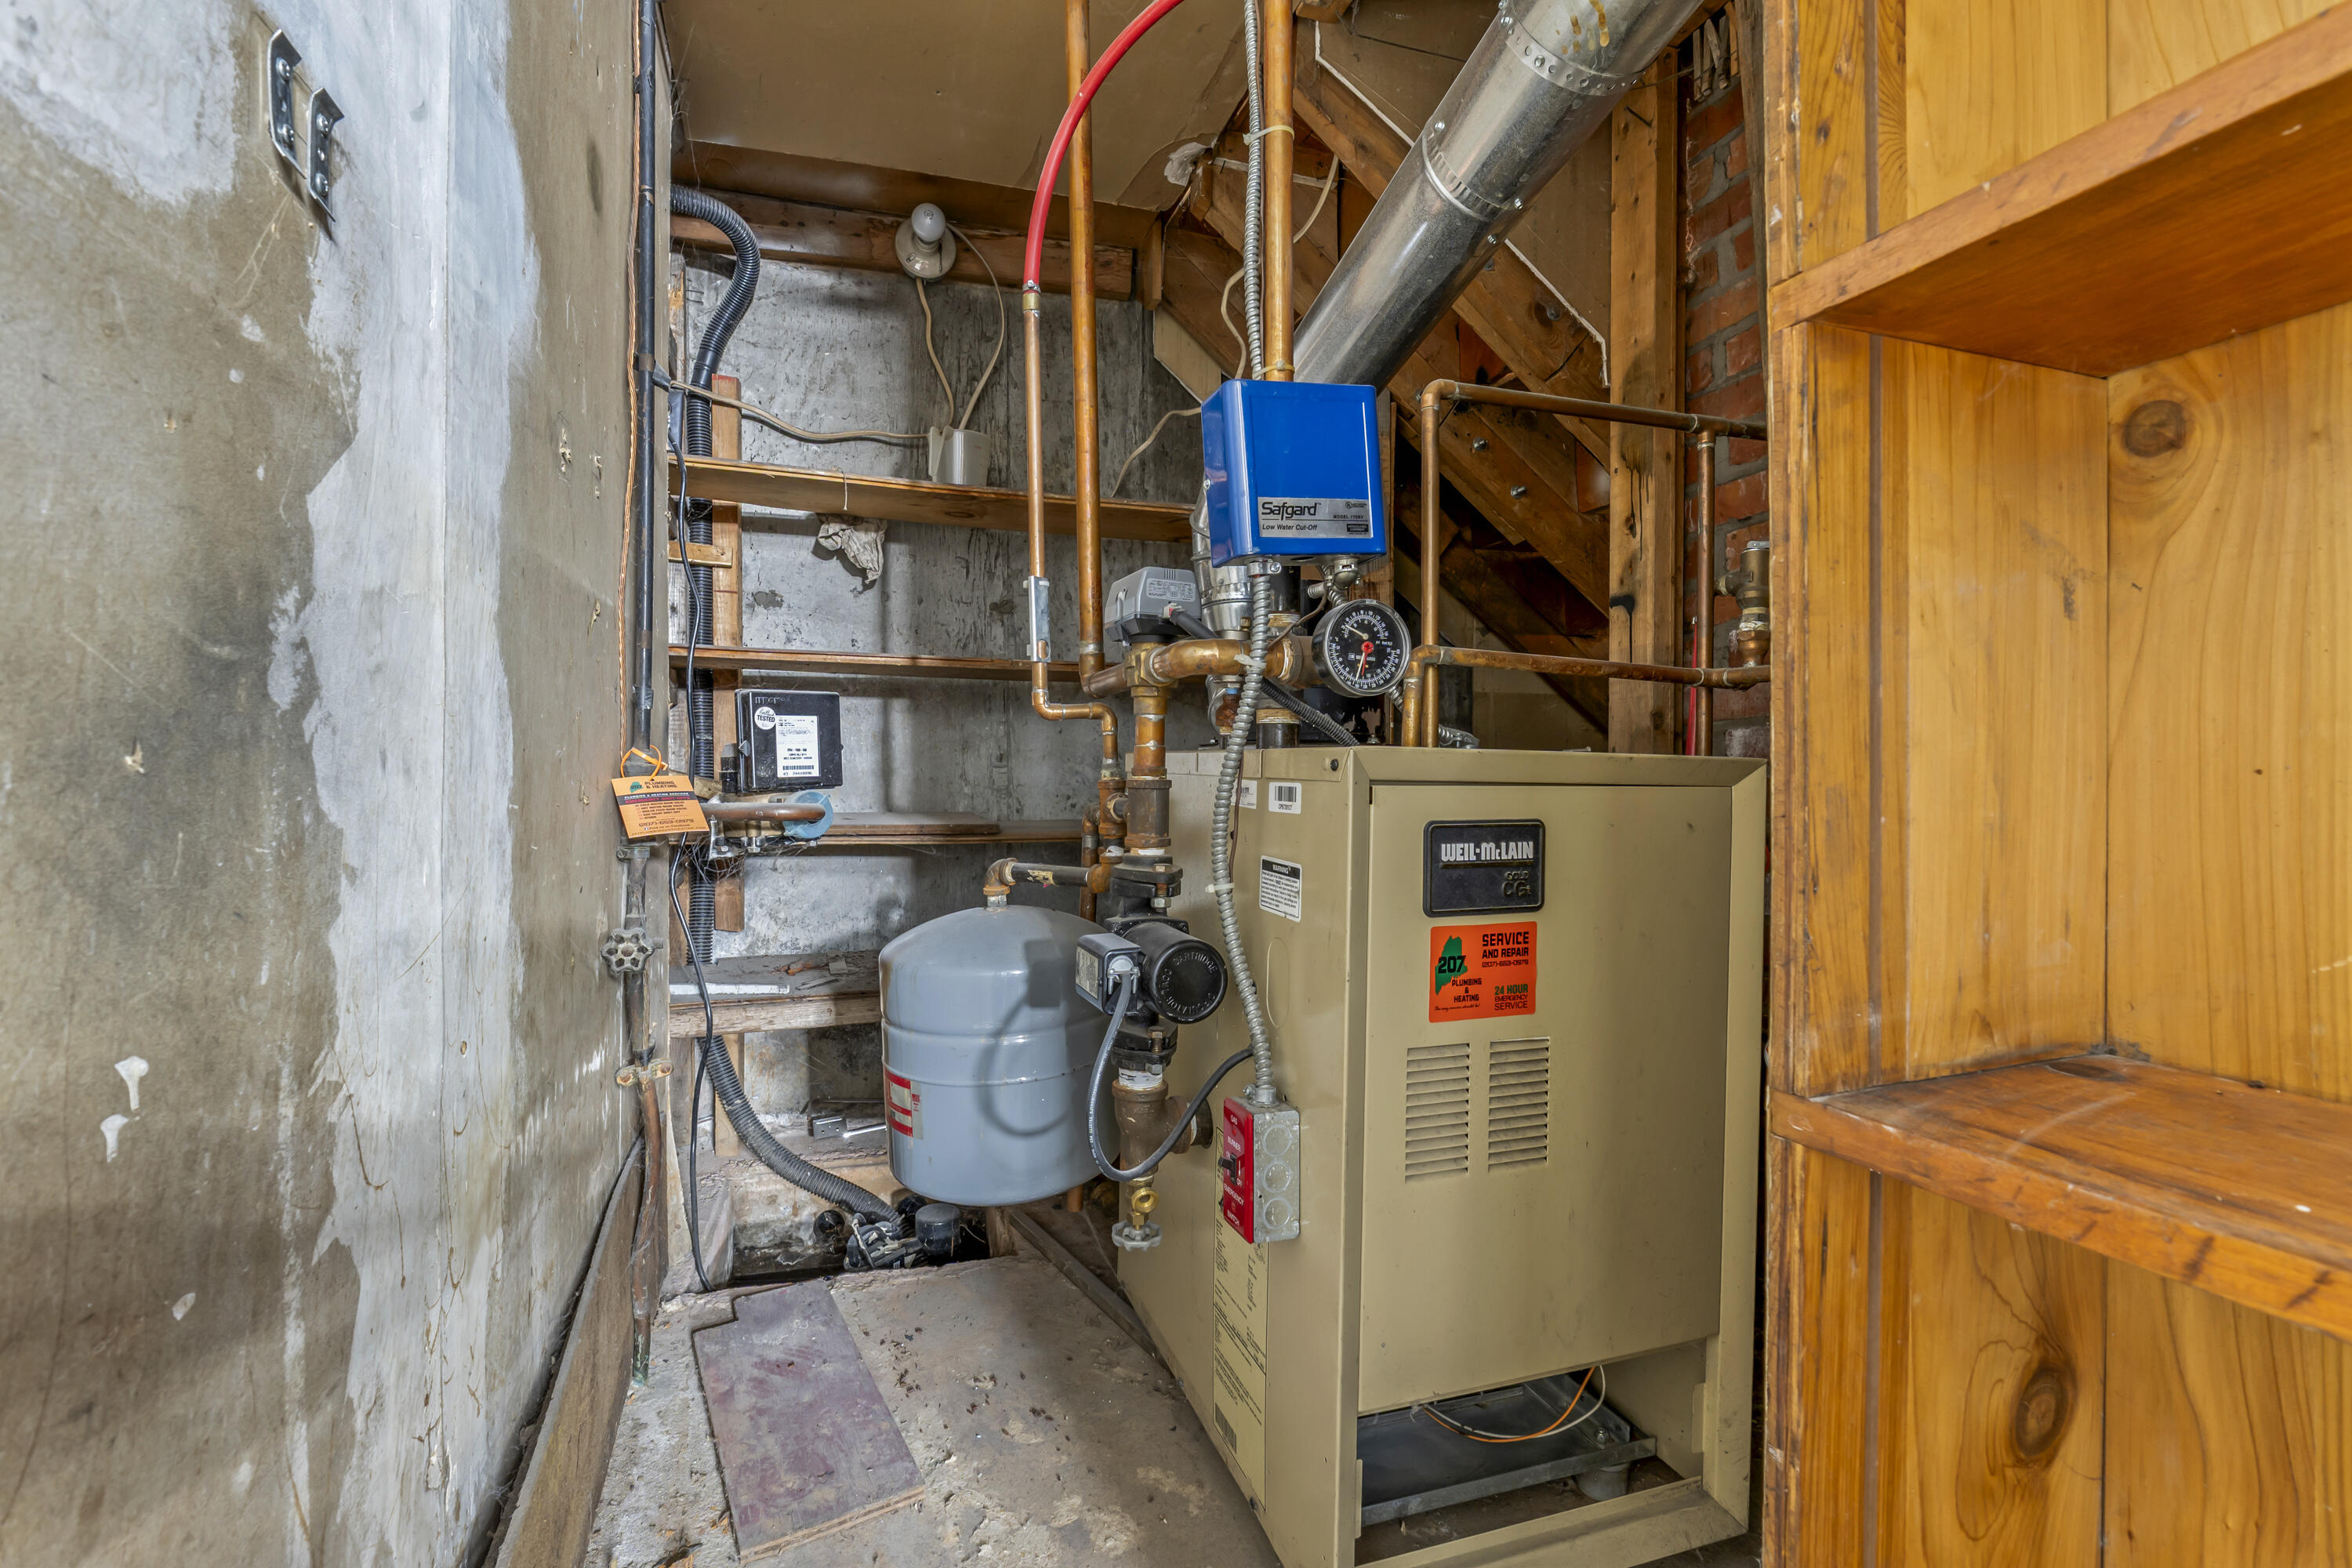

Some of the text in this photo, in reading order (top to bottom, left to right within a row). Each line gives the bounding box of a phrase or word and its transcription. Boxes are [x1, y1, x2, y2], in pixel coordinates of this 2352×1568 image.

[1261, 502, 1317, 521] Safgard
[1482, 931, 1530, 947] SERVICE
[1482, 947, 1529, 959] AND REPAIR
[1438, 955, 1466, 974] 207
[1451, 978, 1482, 986] PLUMBING
[1494, 984, 1528, 996] 24 HOUR
[1454, 993, 1479, 1003] HEATING
[1494, 993, 1528, 1002] EMERGENCY
[1494, 1000, 1528, 1011] SERVICE
[1227, 1136, 1241, 1152] BURNER
[1224, 1182, 1243, 1206] EMERGENCY
[1227, 1210, 1240, 1225] SWITCH
